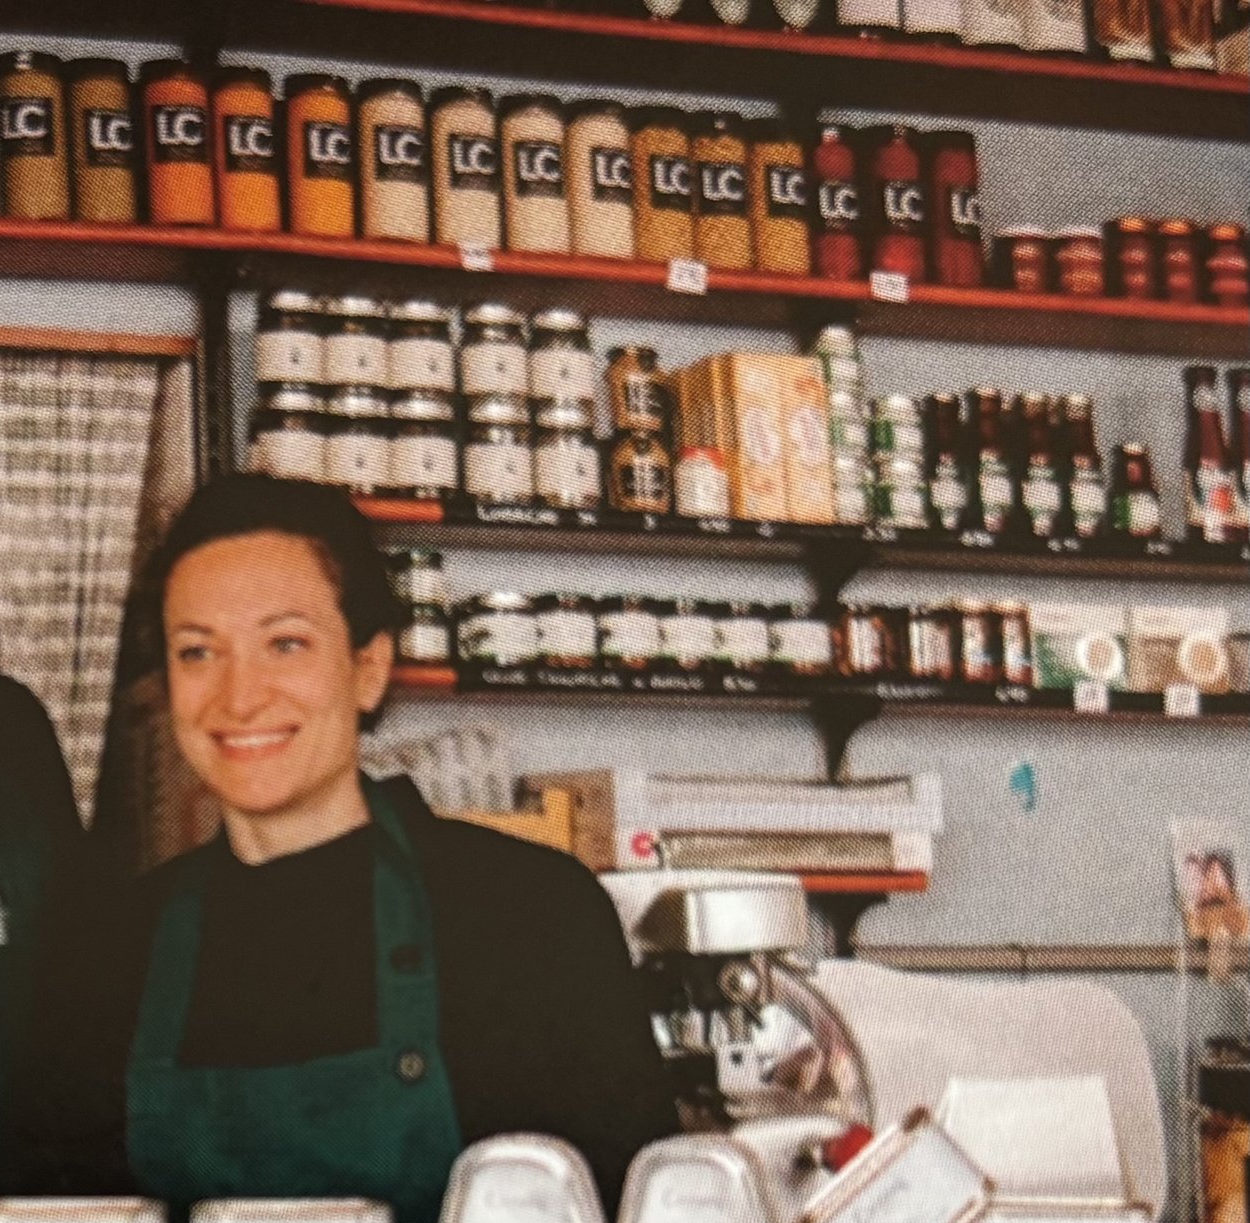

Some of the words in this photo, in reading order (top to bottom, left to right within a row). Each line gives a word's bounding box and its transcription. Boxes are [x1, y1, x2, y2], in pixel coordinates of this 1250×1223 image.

[2, 104, 47, 139] LC
[90, 116, 132, 150] LC
[158, 107, 203, 146] LC
[230, 120, 273, 156] LC
[310, 127, 350, 164] LC
[378, 131, 422, 167] LC
[454, 138, 497, 175] LC
[519, 147, 561, 182] LC
[595, 151, 633, 187] LC
[655, 160, 691, 194] LC
[703, 168, 745, 201] LC
[771, 170, 806, 205] LC
[820, 186, 859, 220] LC
[885, 186, 923, 221] LC
